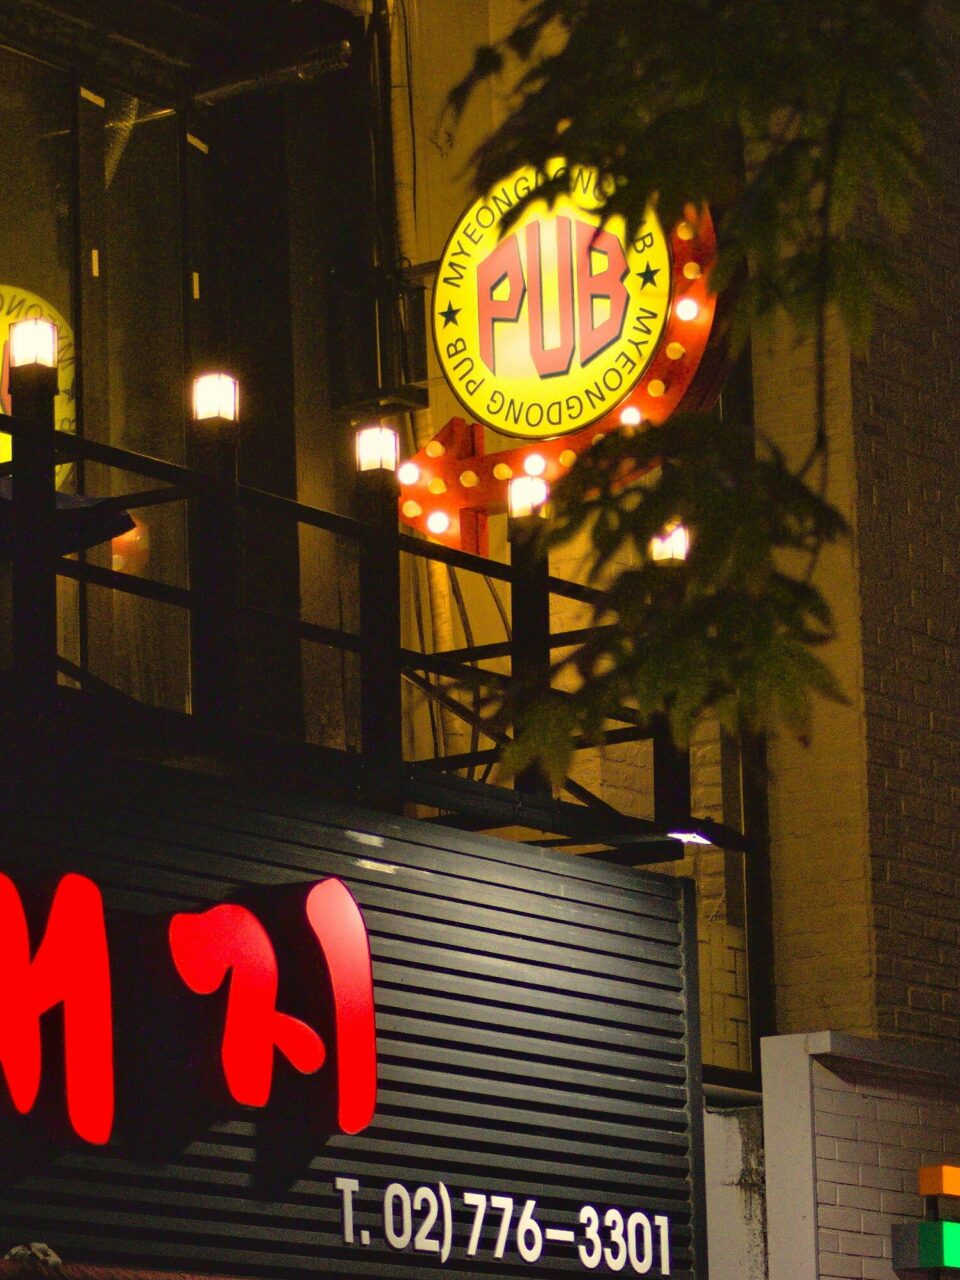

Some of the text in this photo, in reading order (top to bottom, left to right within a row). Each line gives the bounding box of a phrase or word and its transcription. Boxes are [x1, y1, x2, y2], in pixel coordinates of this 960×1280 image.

[477, 214, 631, 381] PUB
[445, 306, 659, 428] MYEONGDONG PUB
[335, 1177, 371, 1246] T.
